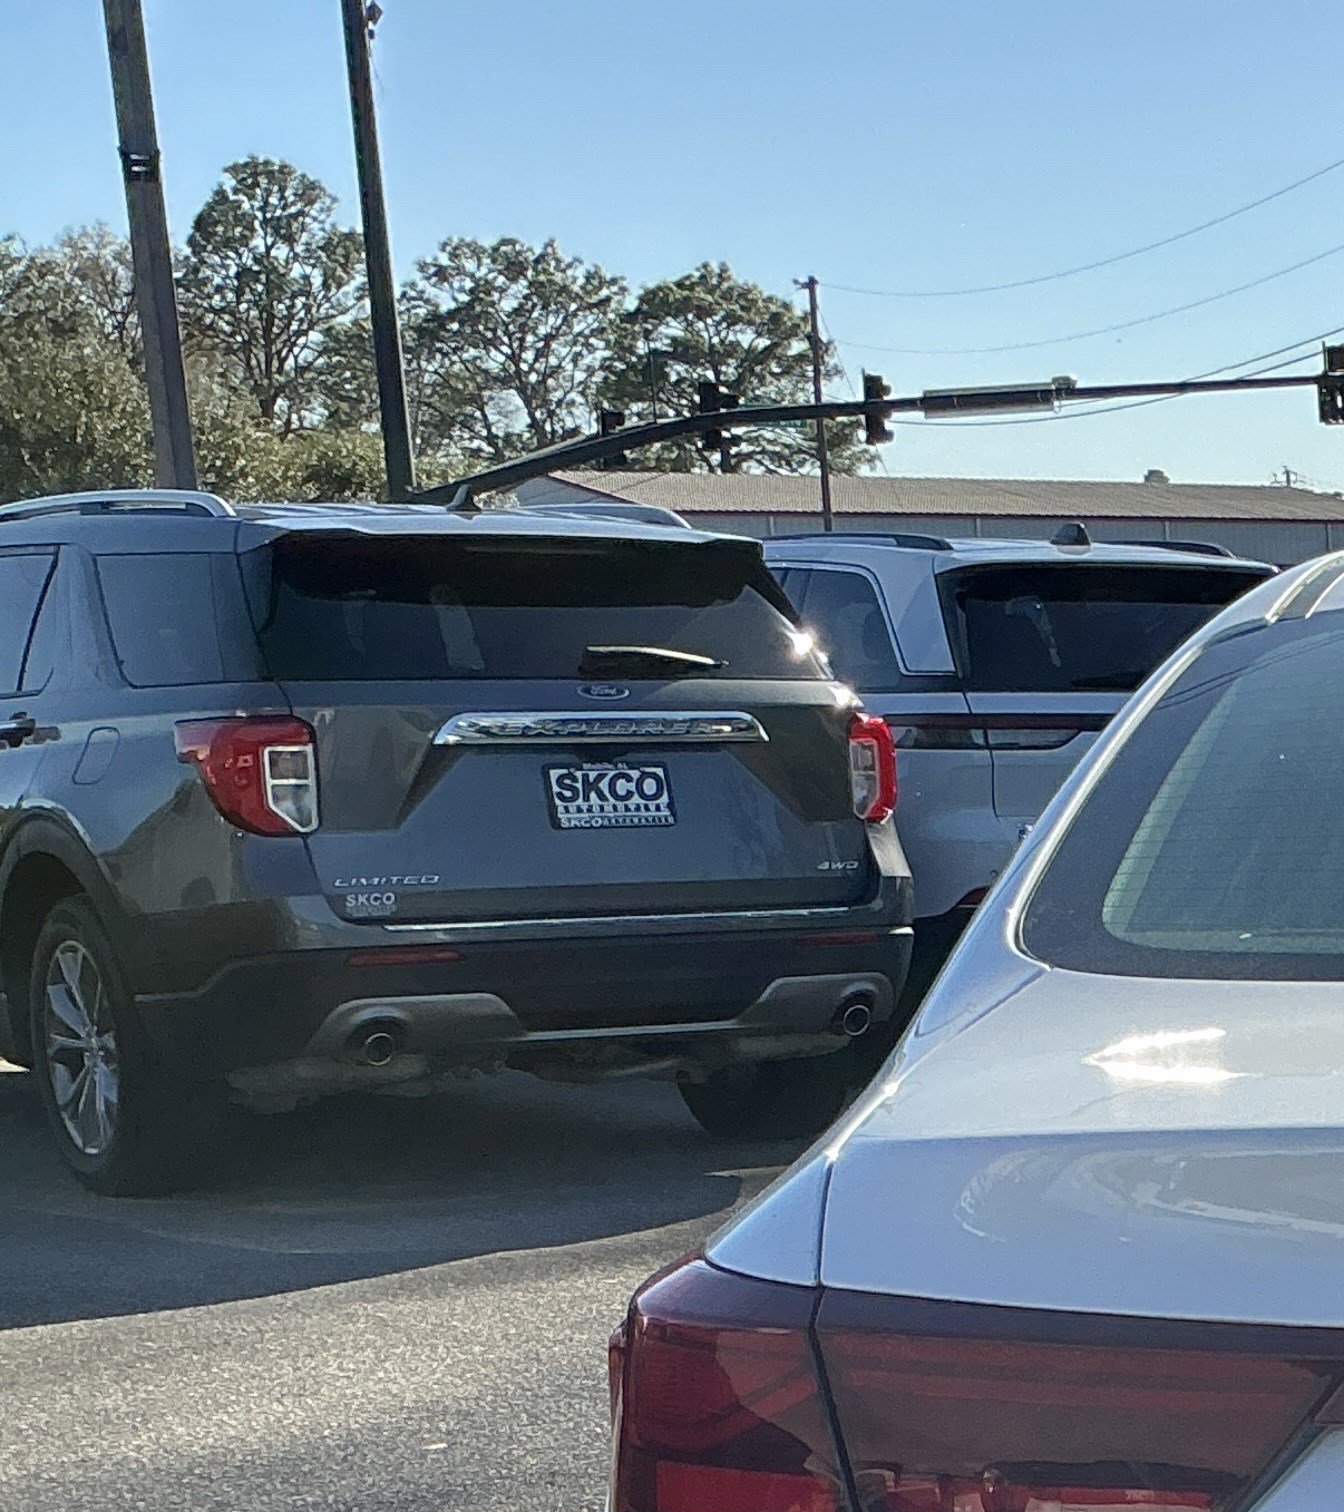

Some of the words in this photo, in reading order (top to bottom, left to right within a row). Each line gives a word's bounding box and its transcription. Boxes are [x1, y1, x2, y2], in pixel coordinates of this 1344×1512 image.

[555, 771, 664, 802] SKCO
[560, 817, 602, 828] SKCO
[816, 860, 860, 870] 4WD
[334, 875, 440, 887] LIMITED
[345, 892, 396, 907] SKCO
